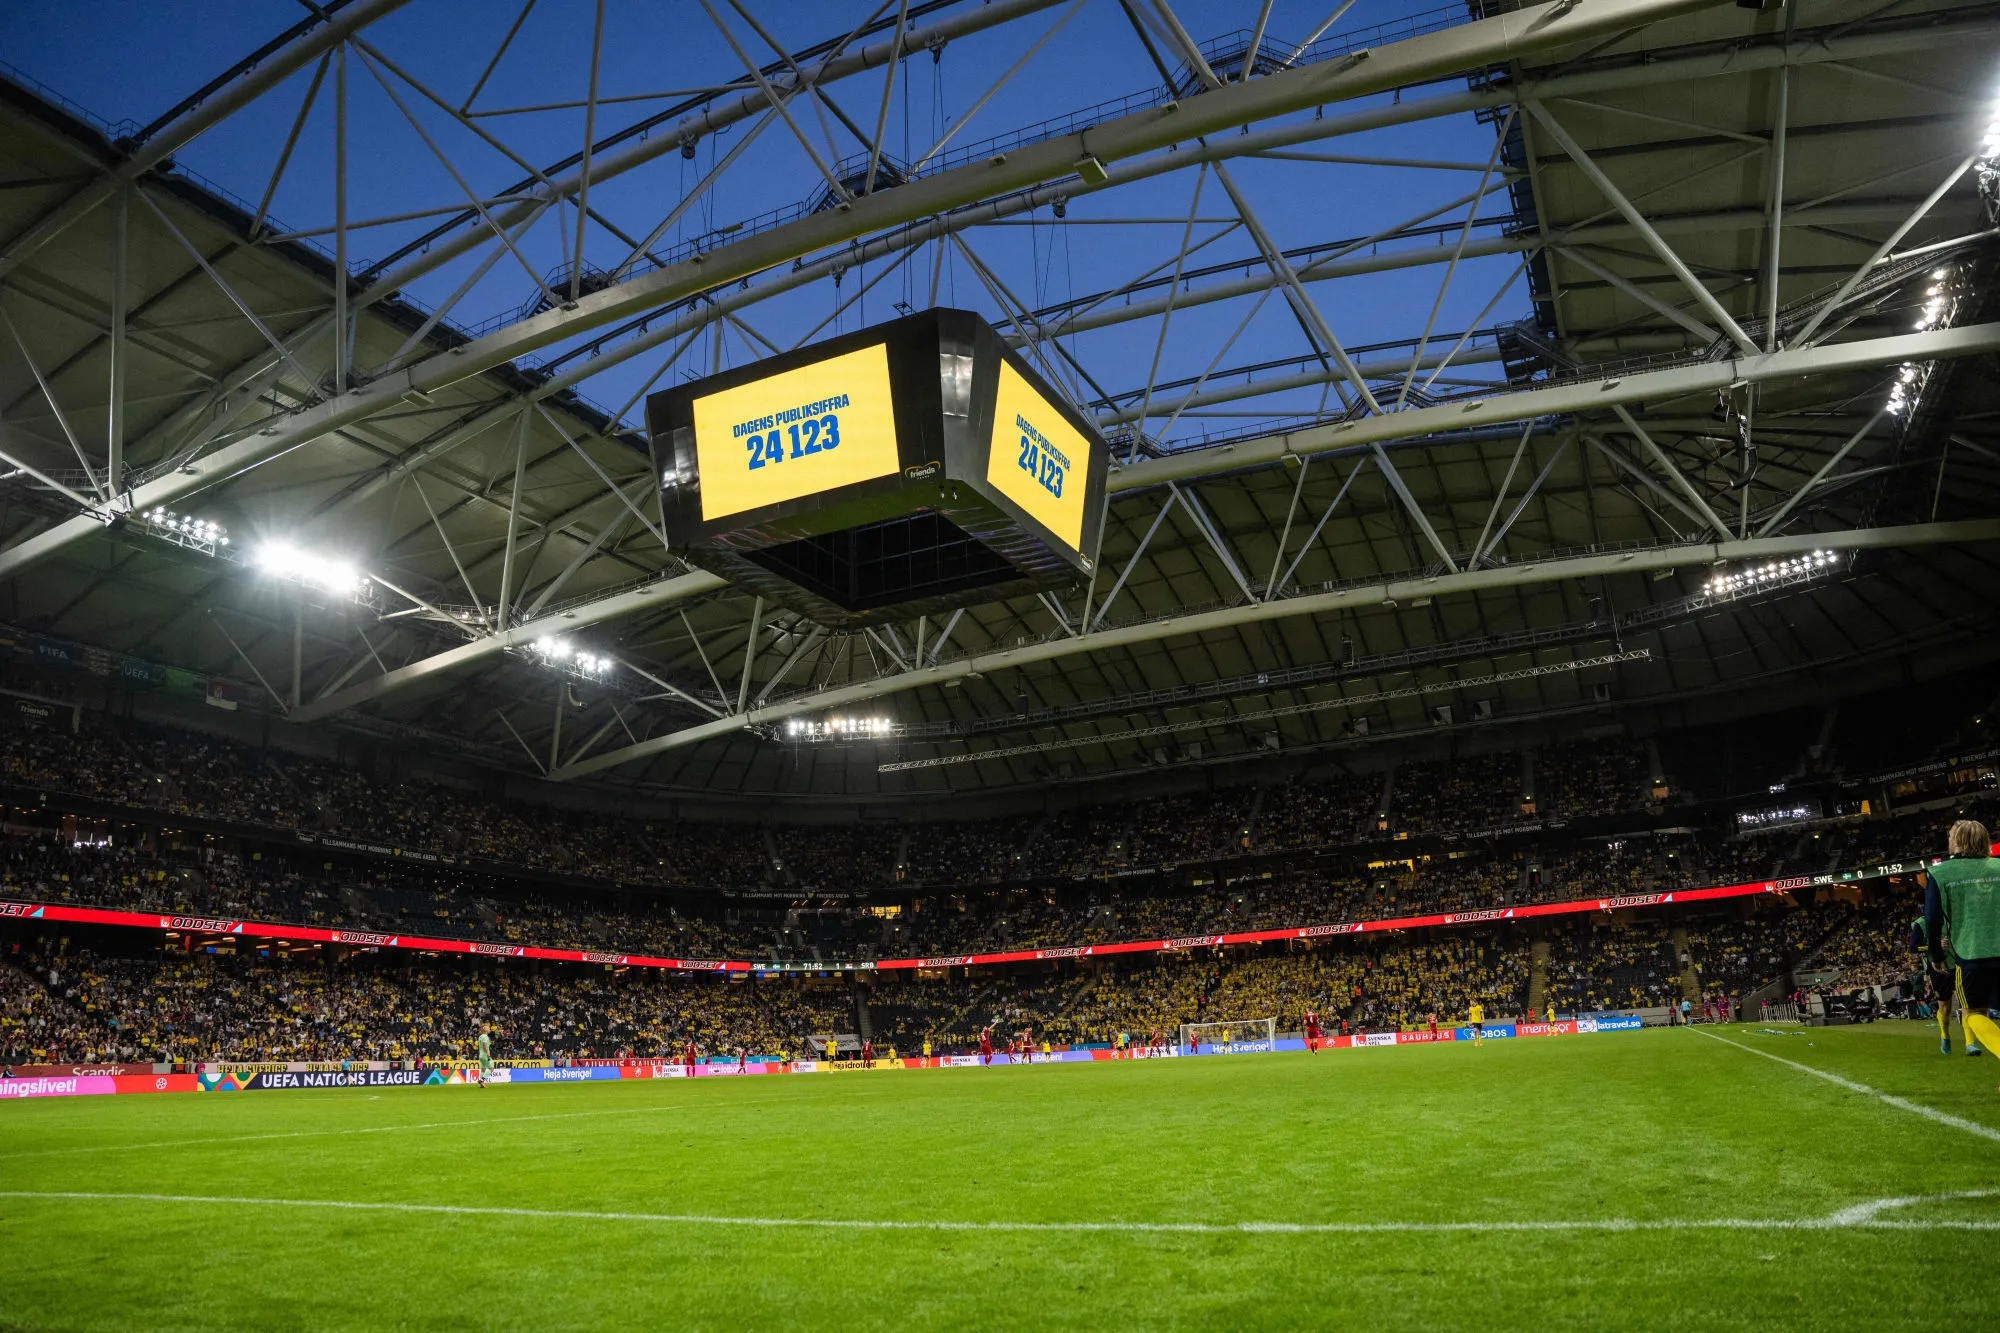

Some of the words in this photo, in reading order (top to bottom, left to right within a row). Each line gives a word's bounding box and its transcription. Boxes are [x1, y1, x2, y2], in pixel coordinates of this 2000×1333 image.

[733, 415, 774, 438] DAGENS
[775, 394, 850, 426] PUBLIKSIFFRA
[746, 429, 784, 470] 24
[788, 414, 840, 460] 123
[1016, 413, 1037, 442] DAGENS
[1037, 432, 1071, 472] PUBLIKSIFFRA
[911, 467, 936, 478] friends
[1018, 435, 1038, 478] 24
[1038, 453, 1063, 499] 123
[39, 645, 68, 660] FIFA
[125, 667, 149, 681] UEFA
[20, 704, 49, 717] friends
[1813, 875, 1833, 884] SWE
[1857, 870, 1863, 879] 0
[1877, 863, 1903, 876] 71:52
[1920, 860, 1925, 869] 1
[1608, 894, 1661, 907] ODDSET
[1453, 909, 1504, 922] ODDSET
[171, 917, 232, 932] ODDSET
[1307, 924, 1353, 935] ODDSET
[340, 932, 389, 945] ODDSET
[1170, 936, 1214, 947] ODDSET
[477, 943, 517, 956] ODDSET
[1044, 948, 1083, 958] ODDSET
[588, 953, 620, 963] ODDSET
[926, 957, 964, 967] ODDSET
[683, 960, 719, 970] ODDSET
[1597, 1020, 1640, 1030] latravel.se
[1234, 1042, 1269, 1053] Sverige!
[72, 1066, 125, 1076] Scandic
[217, 1064, 242, 1073] HEJA
[246, 1064, 288, 1072] SVERIGE
[306, 1063, 330, 1072] HEJA
[262, 1073, 299, 1088] UEFA
[303, 1072, 365, 1086] NATIONS
[369, 1071, 420, 1085] LEAGUE
[544, 1069, 561, 1080] Heja
[562, 1068, 592, 1081] Sverige!
[0, 1078, 77, 1098] ingslivet!
